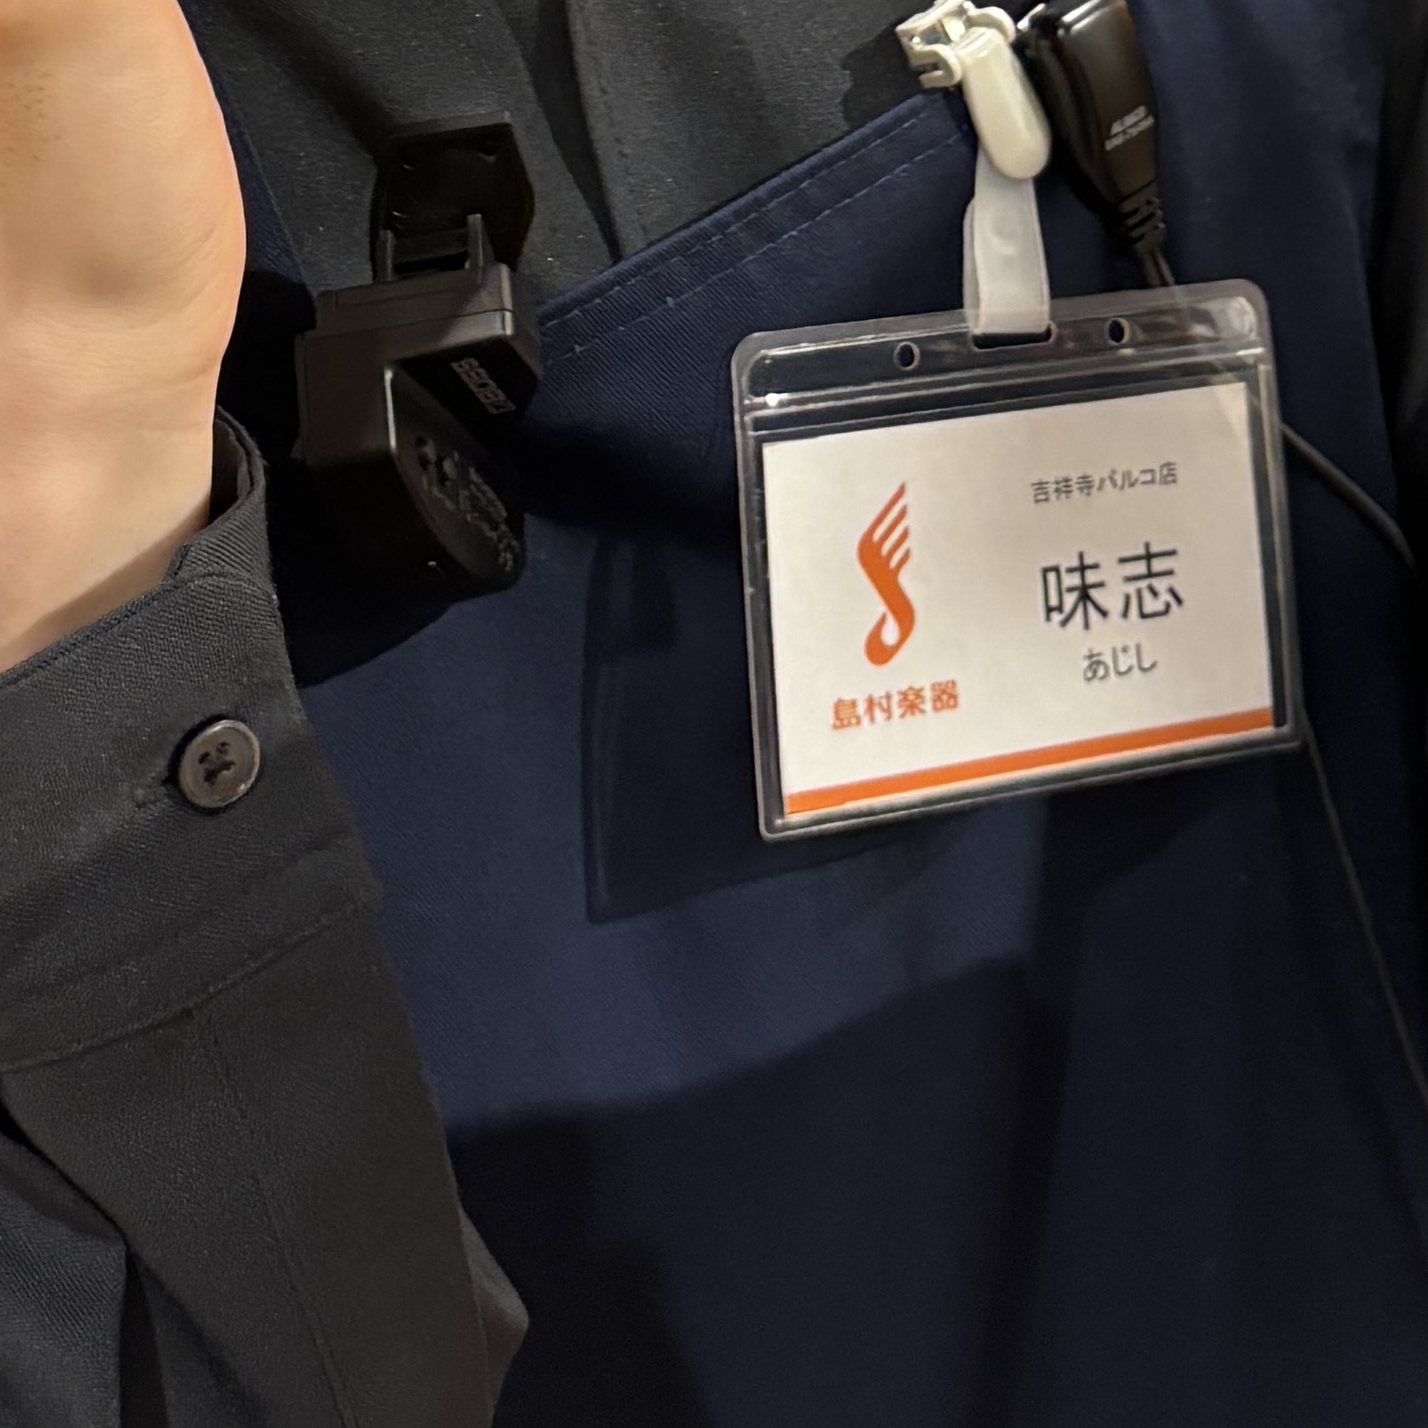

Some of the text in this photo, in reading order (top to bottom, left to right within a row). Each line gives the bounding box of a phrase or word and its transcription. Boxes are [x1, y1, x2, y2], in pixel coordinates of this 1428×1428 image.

[1030, 460, 1179, 505] 吉祥寺パルコ店
[1039, 540, 1185, 632] 味志
[1081, 643, 1159, 684] あじし
[829, 678, 961, 732] 島村楽器
